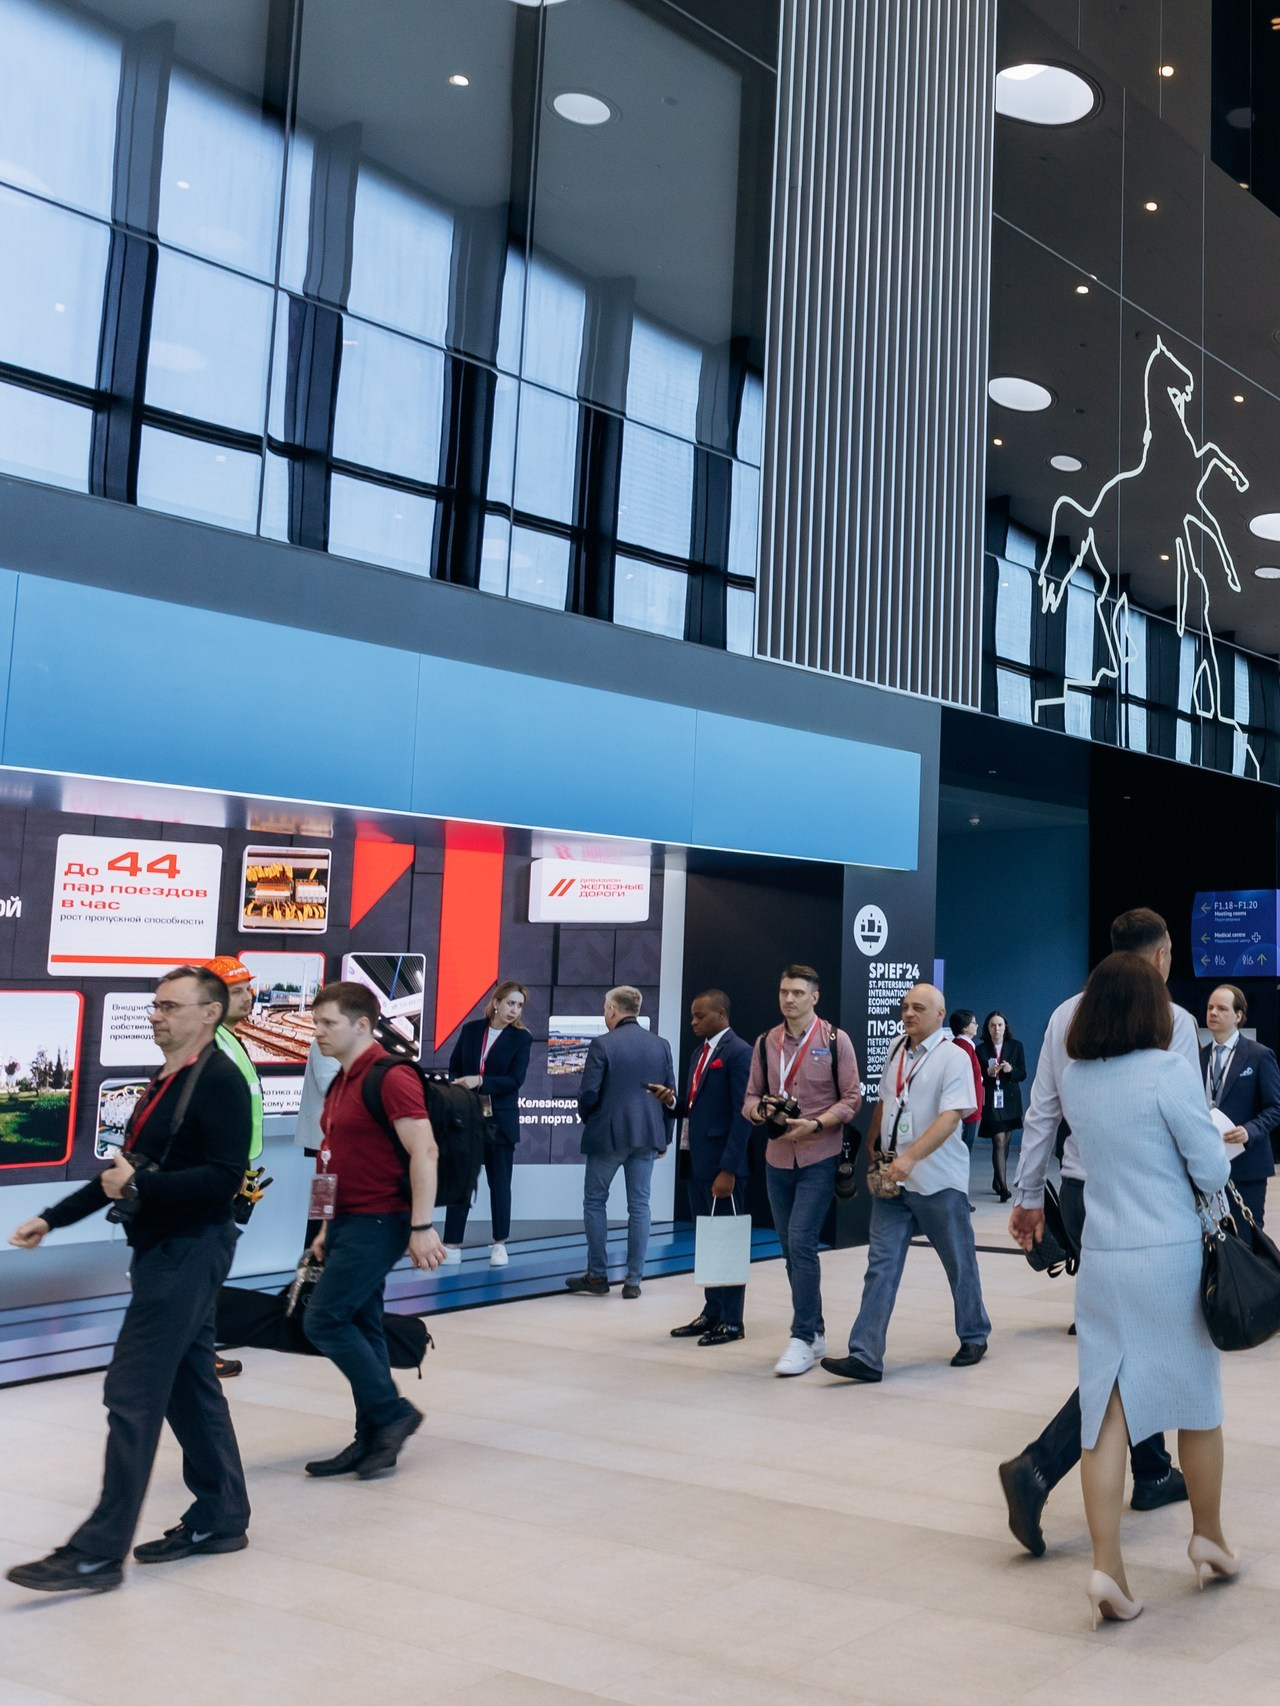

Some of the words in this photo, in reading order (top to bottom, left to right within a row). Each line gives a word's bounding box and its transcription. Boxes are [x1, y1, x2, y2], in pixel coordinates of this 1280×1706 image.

[64, 862, 99, 877] До
[108, 852, 180, 878] 44
[62, 882, 104, 895] пар
[110, 885, 208, 898] поездов
[62, 899, 74, 908] в
[80, 900, 120, 910] час
[60, 914, 82, 922] рост
[85, 914, 142, 924] пропускной
[144, 917, 204, 926] способности
[869, 962, 920, 979] SPIEF'24
[868, 980, 877, 988] ST.
[878, 980, 914, 989] PETERSBURG
[868, 1006, 890, 1014] FORUM
[541, 1115, 573, 1126] порта
